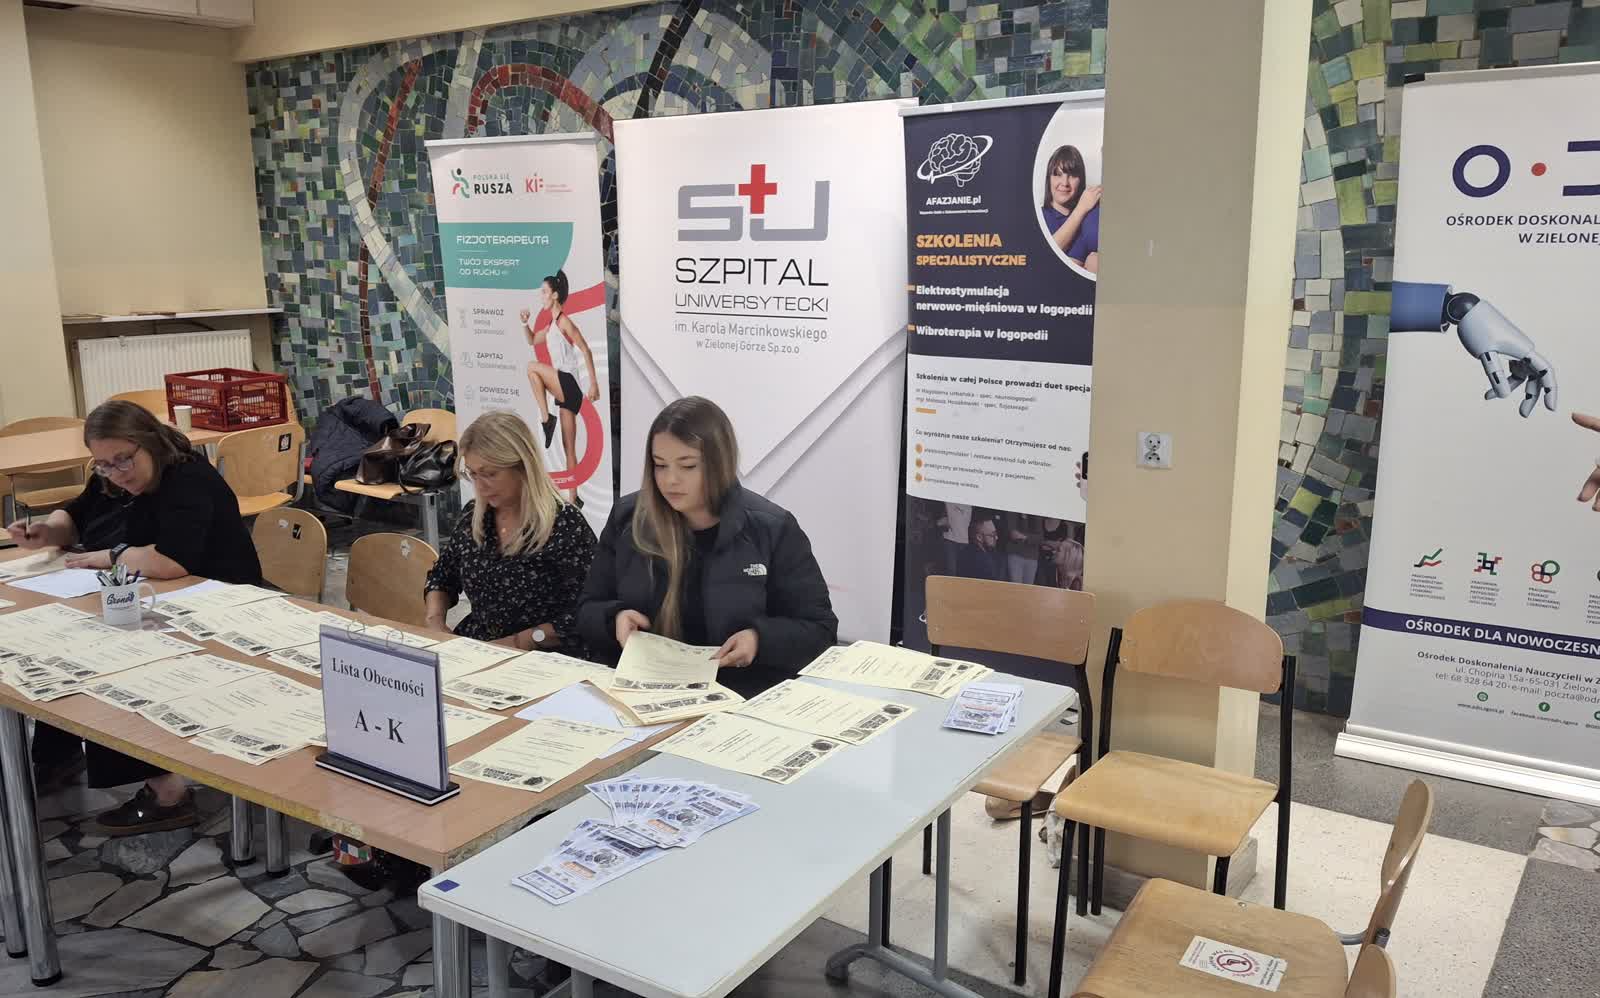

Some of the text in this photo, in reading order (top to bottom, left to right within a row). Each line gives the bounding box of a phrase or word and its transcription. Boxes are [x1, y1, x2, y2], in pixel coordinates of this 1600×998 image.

[474, 182, 513, 194] RUSZA
[926, 195, 981, 206] AFAZJANIE.pl
[1446, 213, 1600, 226] OŚRODEK DOSKONAL
[456, 235, 549, 245] FIZJOTERAPEUTA
[916, 233, 1002, 248] SZKOLENIA
[1519, 232, 1600, 245] W ZIELONE
[483, 258, 520, 266] EKSPERT
[916, 254, 1026, 267] SPECJALISTYCZNE
[459, 268, 500, 276] OD RUCHU
[675, 257, 829, 286] SZPITAL
[916, 285, 1009, 297] Elektrostymulacja
[675, 294, 829, 312] UNIWERSYTECKI
[916, 302, 1024, 314] nerwowo-mięśniowa
[1040, 303, 1093, 317] logopedii
[692, 321, 726, 335] Karola
[728, 323, 828, 343] Marcinkowskiego
[916, 325, 1048, 341] Wibroterapia w logopedii
[696, 340, 703, 348] w
[705, 339, 738, 353] Zielonej
[916, 373, 949, 382] Szkolenia
[960, 376, 977, 385] całej
[978, 377, 1003, 385] Polsce
[1005, 380, 1042, 389] prowadzi
[1044, 382, 1063, 390] duet
[1065, 384, 1091, 393] specja
[1005, 439, 1046, 449] Otrzymujesz
[1405, 619, 1600, 656] OŚRODEK DLA NOWOCZESN
[1417, 651, 1456, 662] Ośrodek
[1458, 657, 1523, 673] Doskonalenia
[1525, 667, 1582, 681] Nauczycieli
[332, 657, 425, 697] Lista Obecności
[1464, 677, 1480, 685] 328
[1482, 679, 1493, 687] 64
[1468, 667, 1505, 680] Chopina
[1563, 682, 1597, 694] Zielona
[355, 709, 369, 732] A
[387, 717, 406, 744] K
